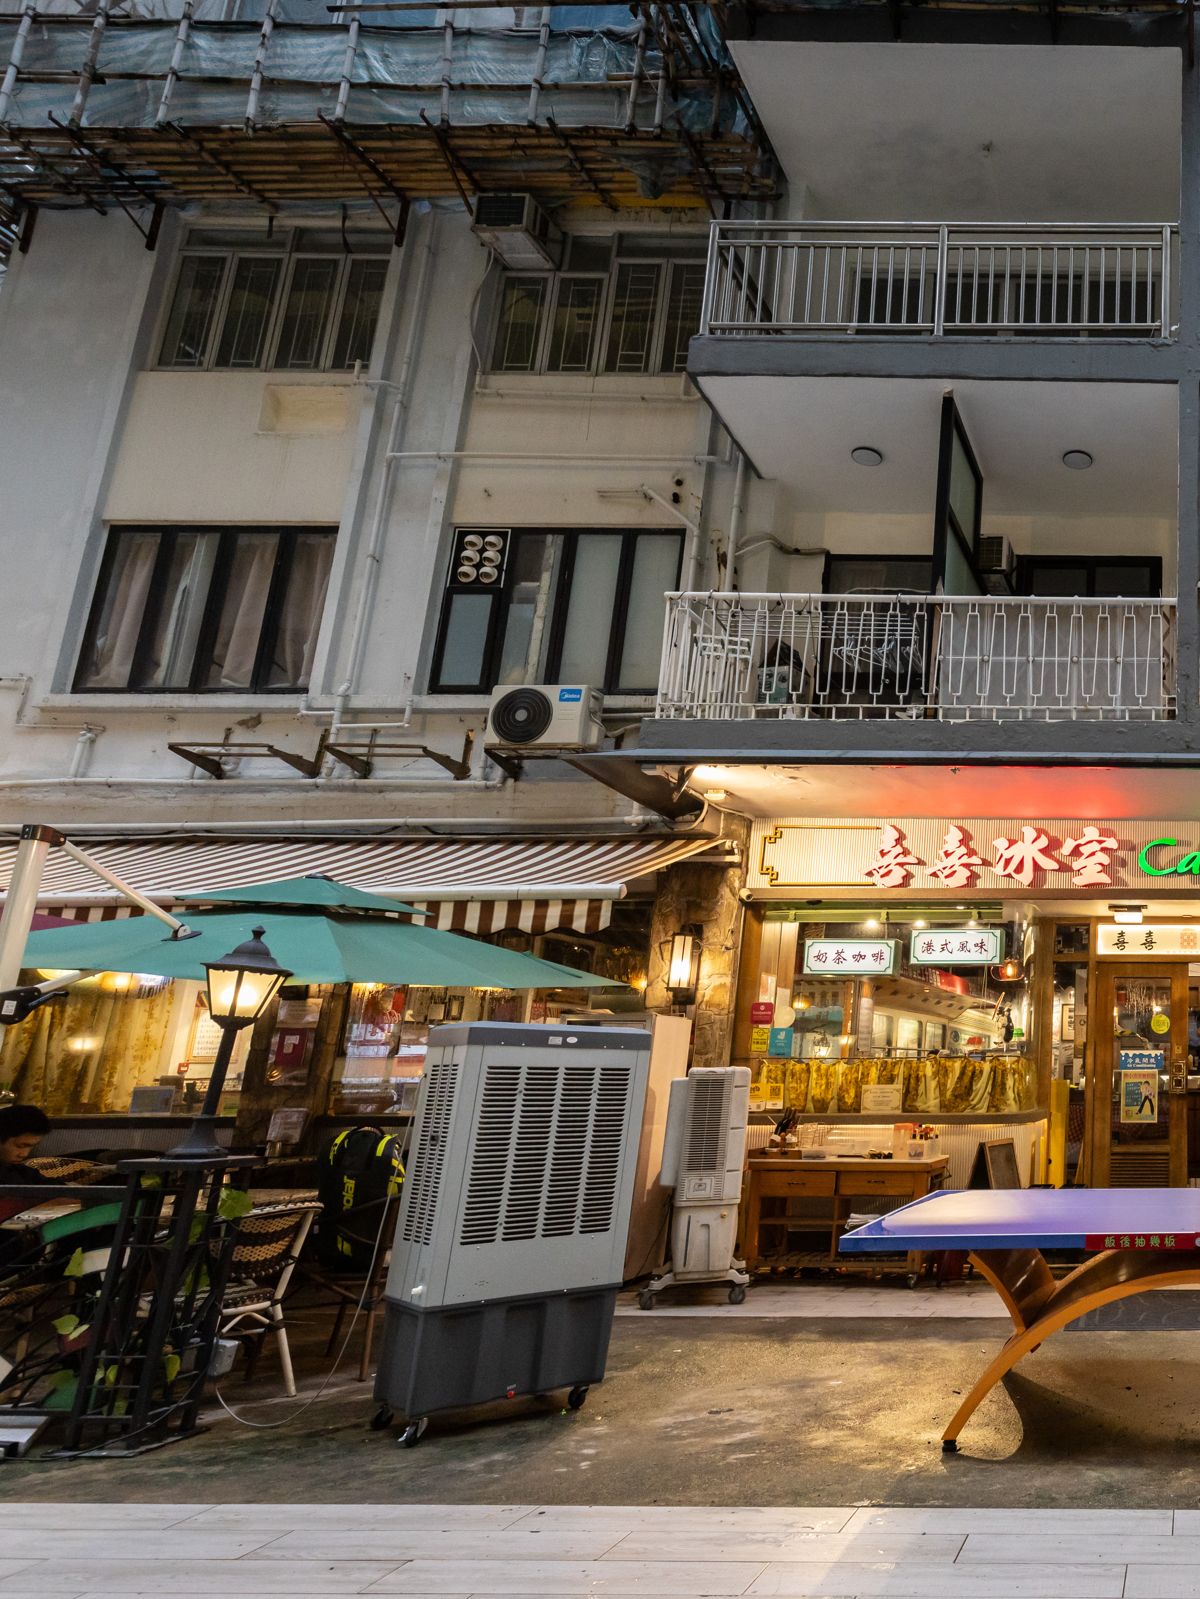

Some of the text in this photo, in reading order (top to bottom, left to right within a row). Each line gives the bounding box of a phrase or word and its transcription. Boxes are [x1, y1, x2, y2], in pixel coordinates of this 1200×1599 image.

[862, 824, 1118, 888] 喜喜冰室
[921, 939, 989, 956] 港式風味
[812, 949, 886, 966] 奶茶咖啡
